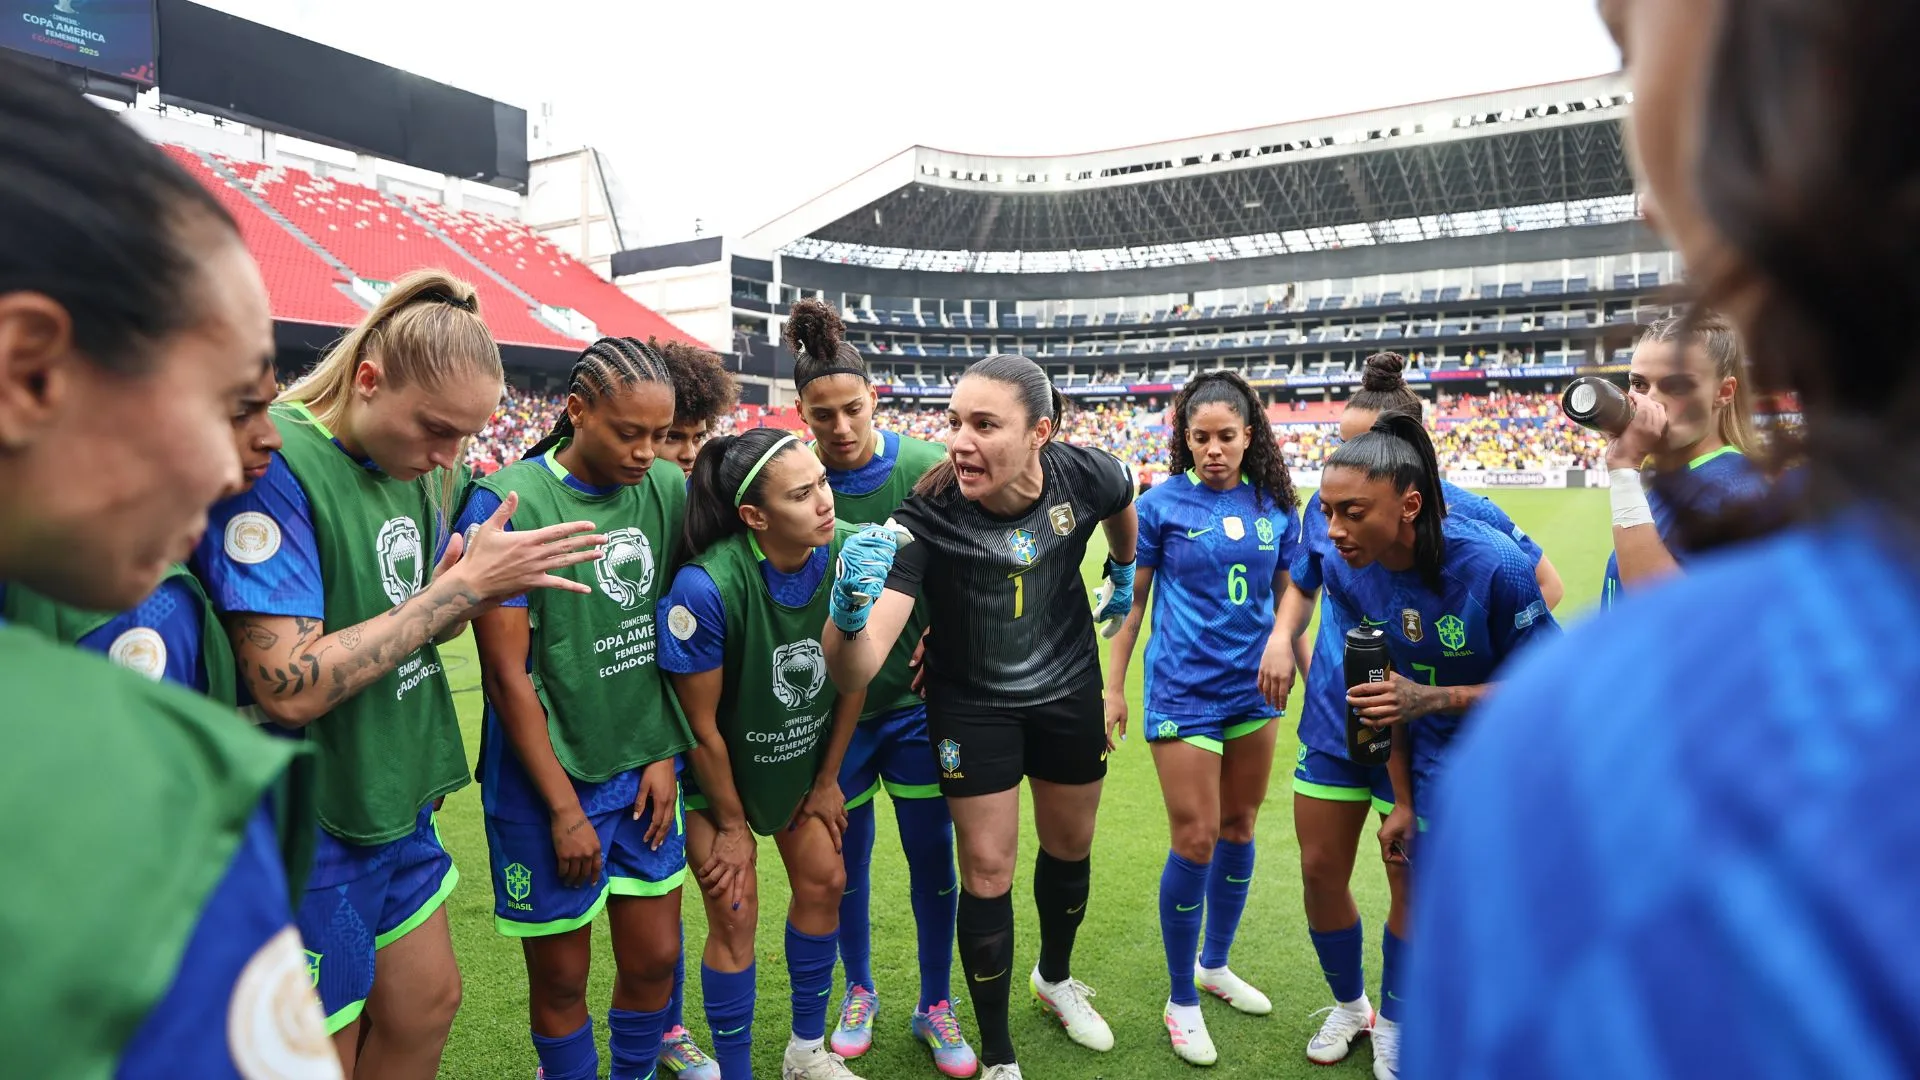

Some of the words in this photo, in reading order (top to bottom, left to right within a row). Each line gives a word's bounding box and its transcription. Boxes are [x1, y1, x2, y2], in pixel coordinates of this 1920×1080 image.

[23, 13, 54, 28] COPA
[45, 29, 86, 46] FEMENINA
[79, 46, 100, 57] 2025
[1228, 564, 1248, 605] 6
[1014, 575, 1023, 619] 1
[622, 614, 652, 630] CONMEBOL
[594, 634, 624, 654] OPA
[615, 640, 656, 660] FEMENIN
[600, 653, 654, 678] ECUADOR
[784, 714, 812, 728] CONMEBOL
[746, 731, 785, 743] COPA
[774, 732, 816, 752] FEMENINA
[754, 746, 807, 763] ECUADOR
[507, 900, 533, 911] BRASIL
